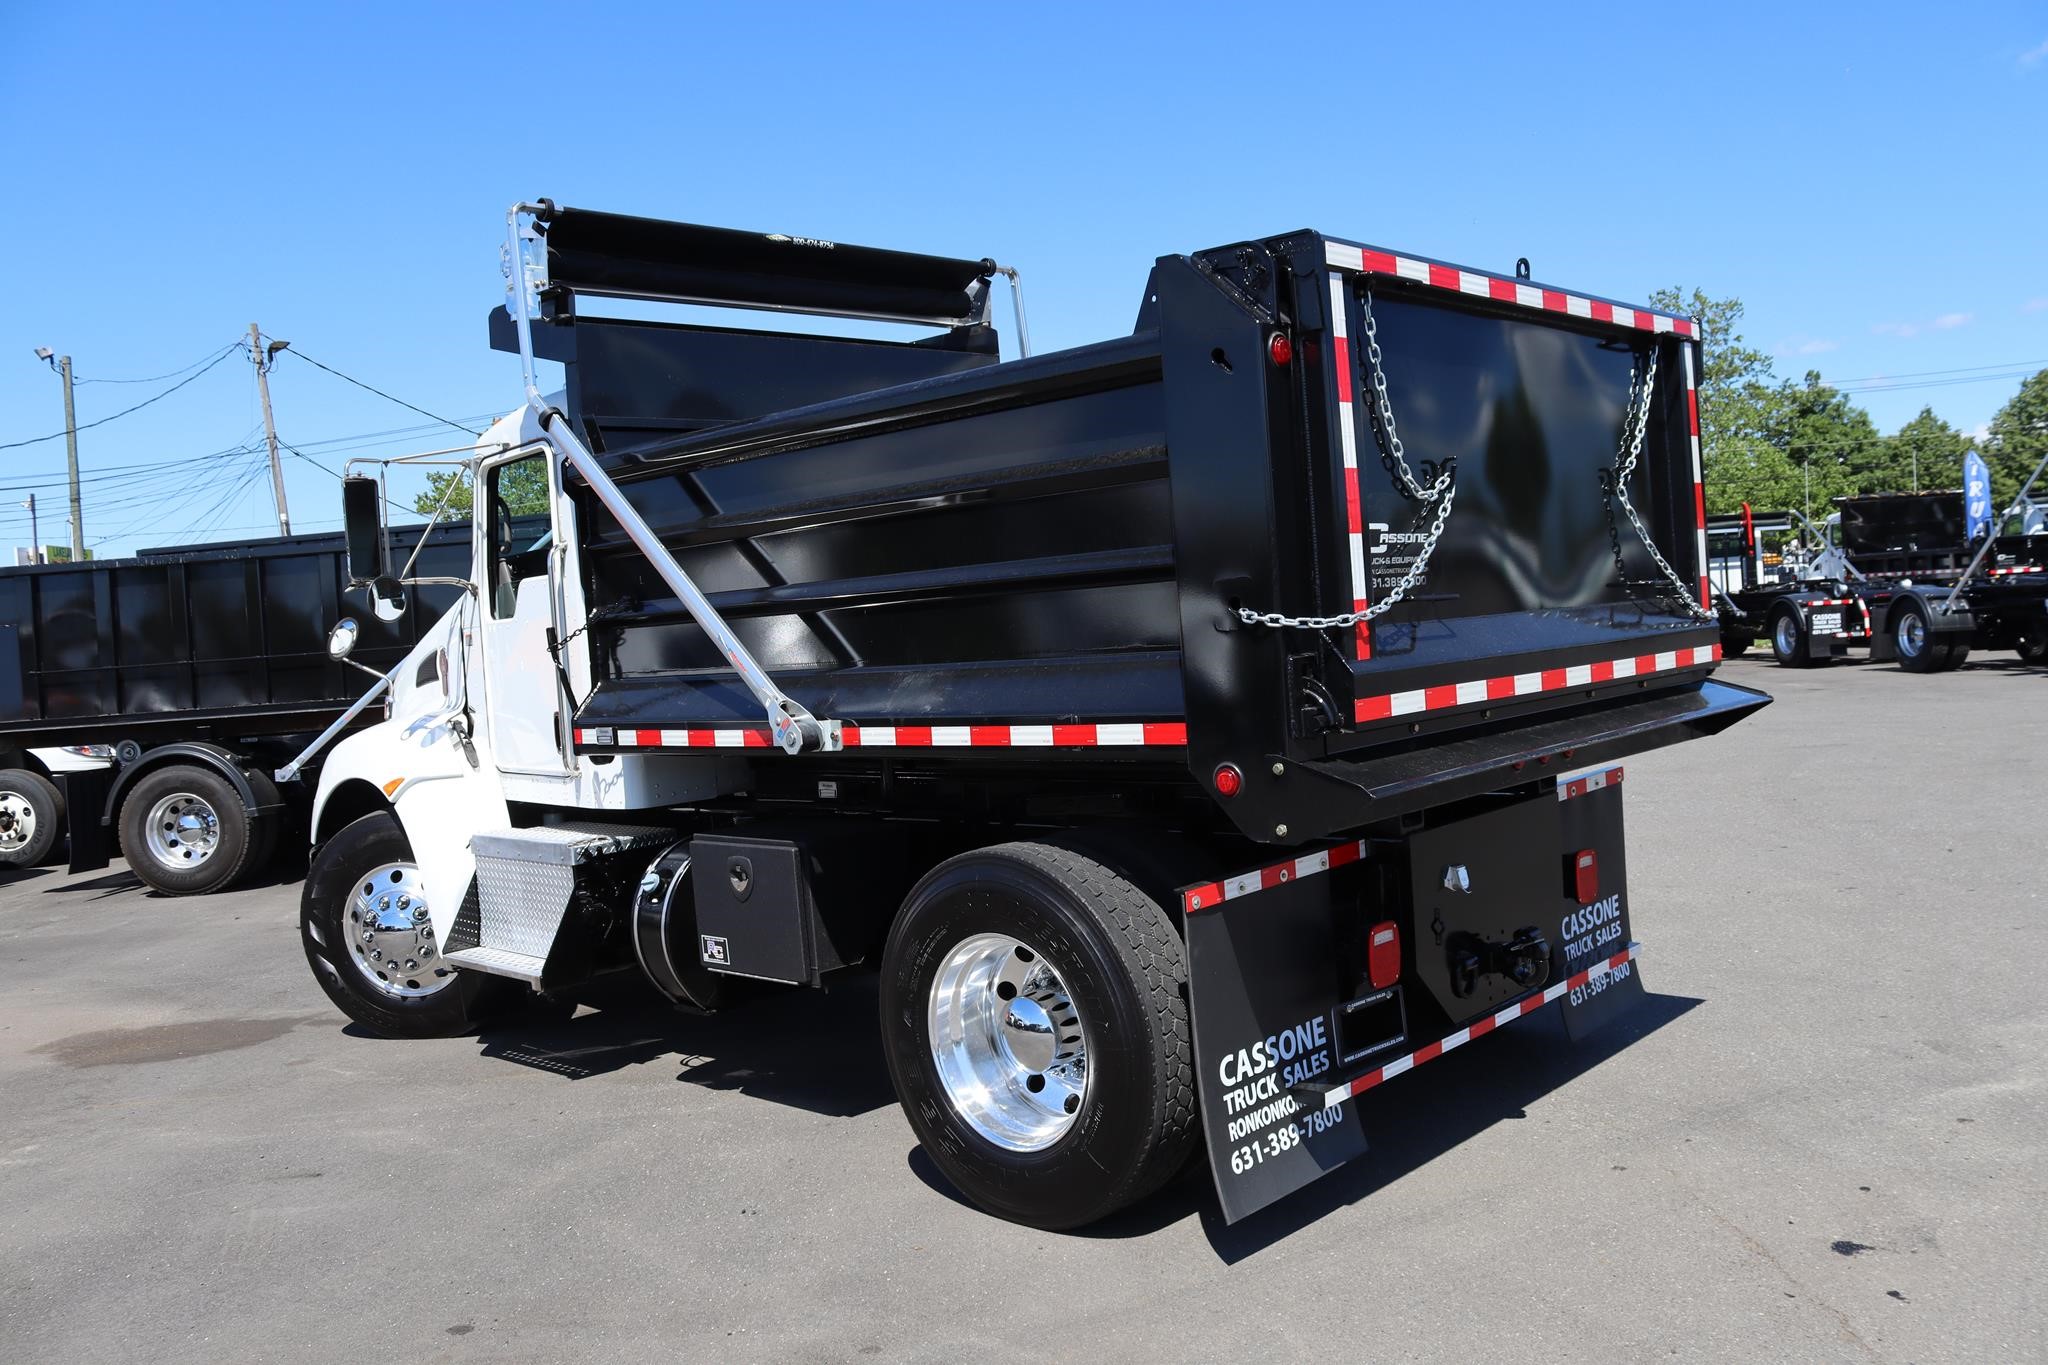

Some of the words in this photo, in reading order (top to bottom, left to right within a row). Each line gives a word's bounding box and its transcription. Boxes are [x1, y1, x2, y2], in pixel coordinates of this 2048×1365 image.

[1561, 893, 1620, 941] CASSONE
[1564, 933, 1594, 962] TRUCK
[1596, 920, 1622, 947] SALES
[1570, 961, 1630, 1007] 631-389-7800
[1219, 1015, 1327, 1087] CASSONE
[1223, 1072, 1280, 1116] TRUCK
[1283, 1050, 1330, 1089] SALES
[1228, 1094, 1308, 1143] RONKONKO
[1231, 1104, 1343, 1175] 631-389-7800
